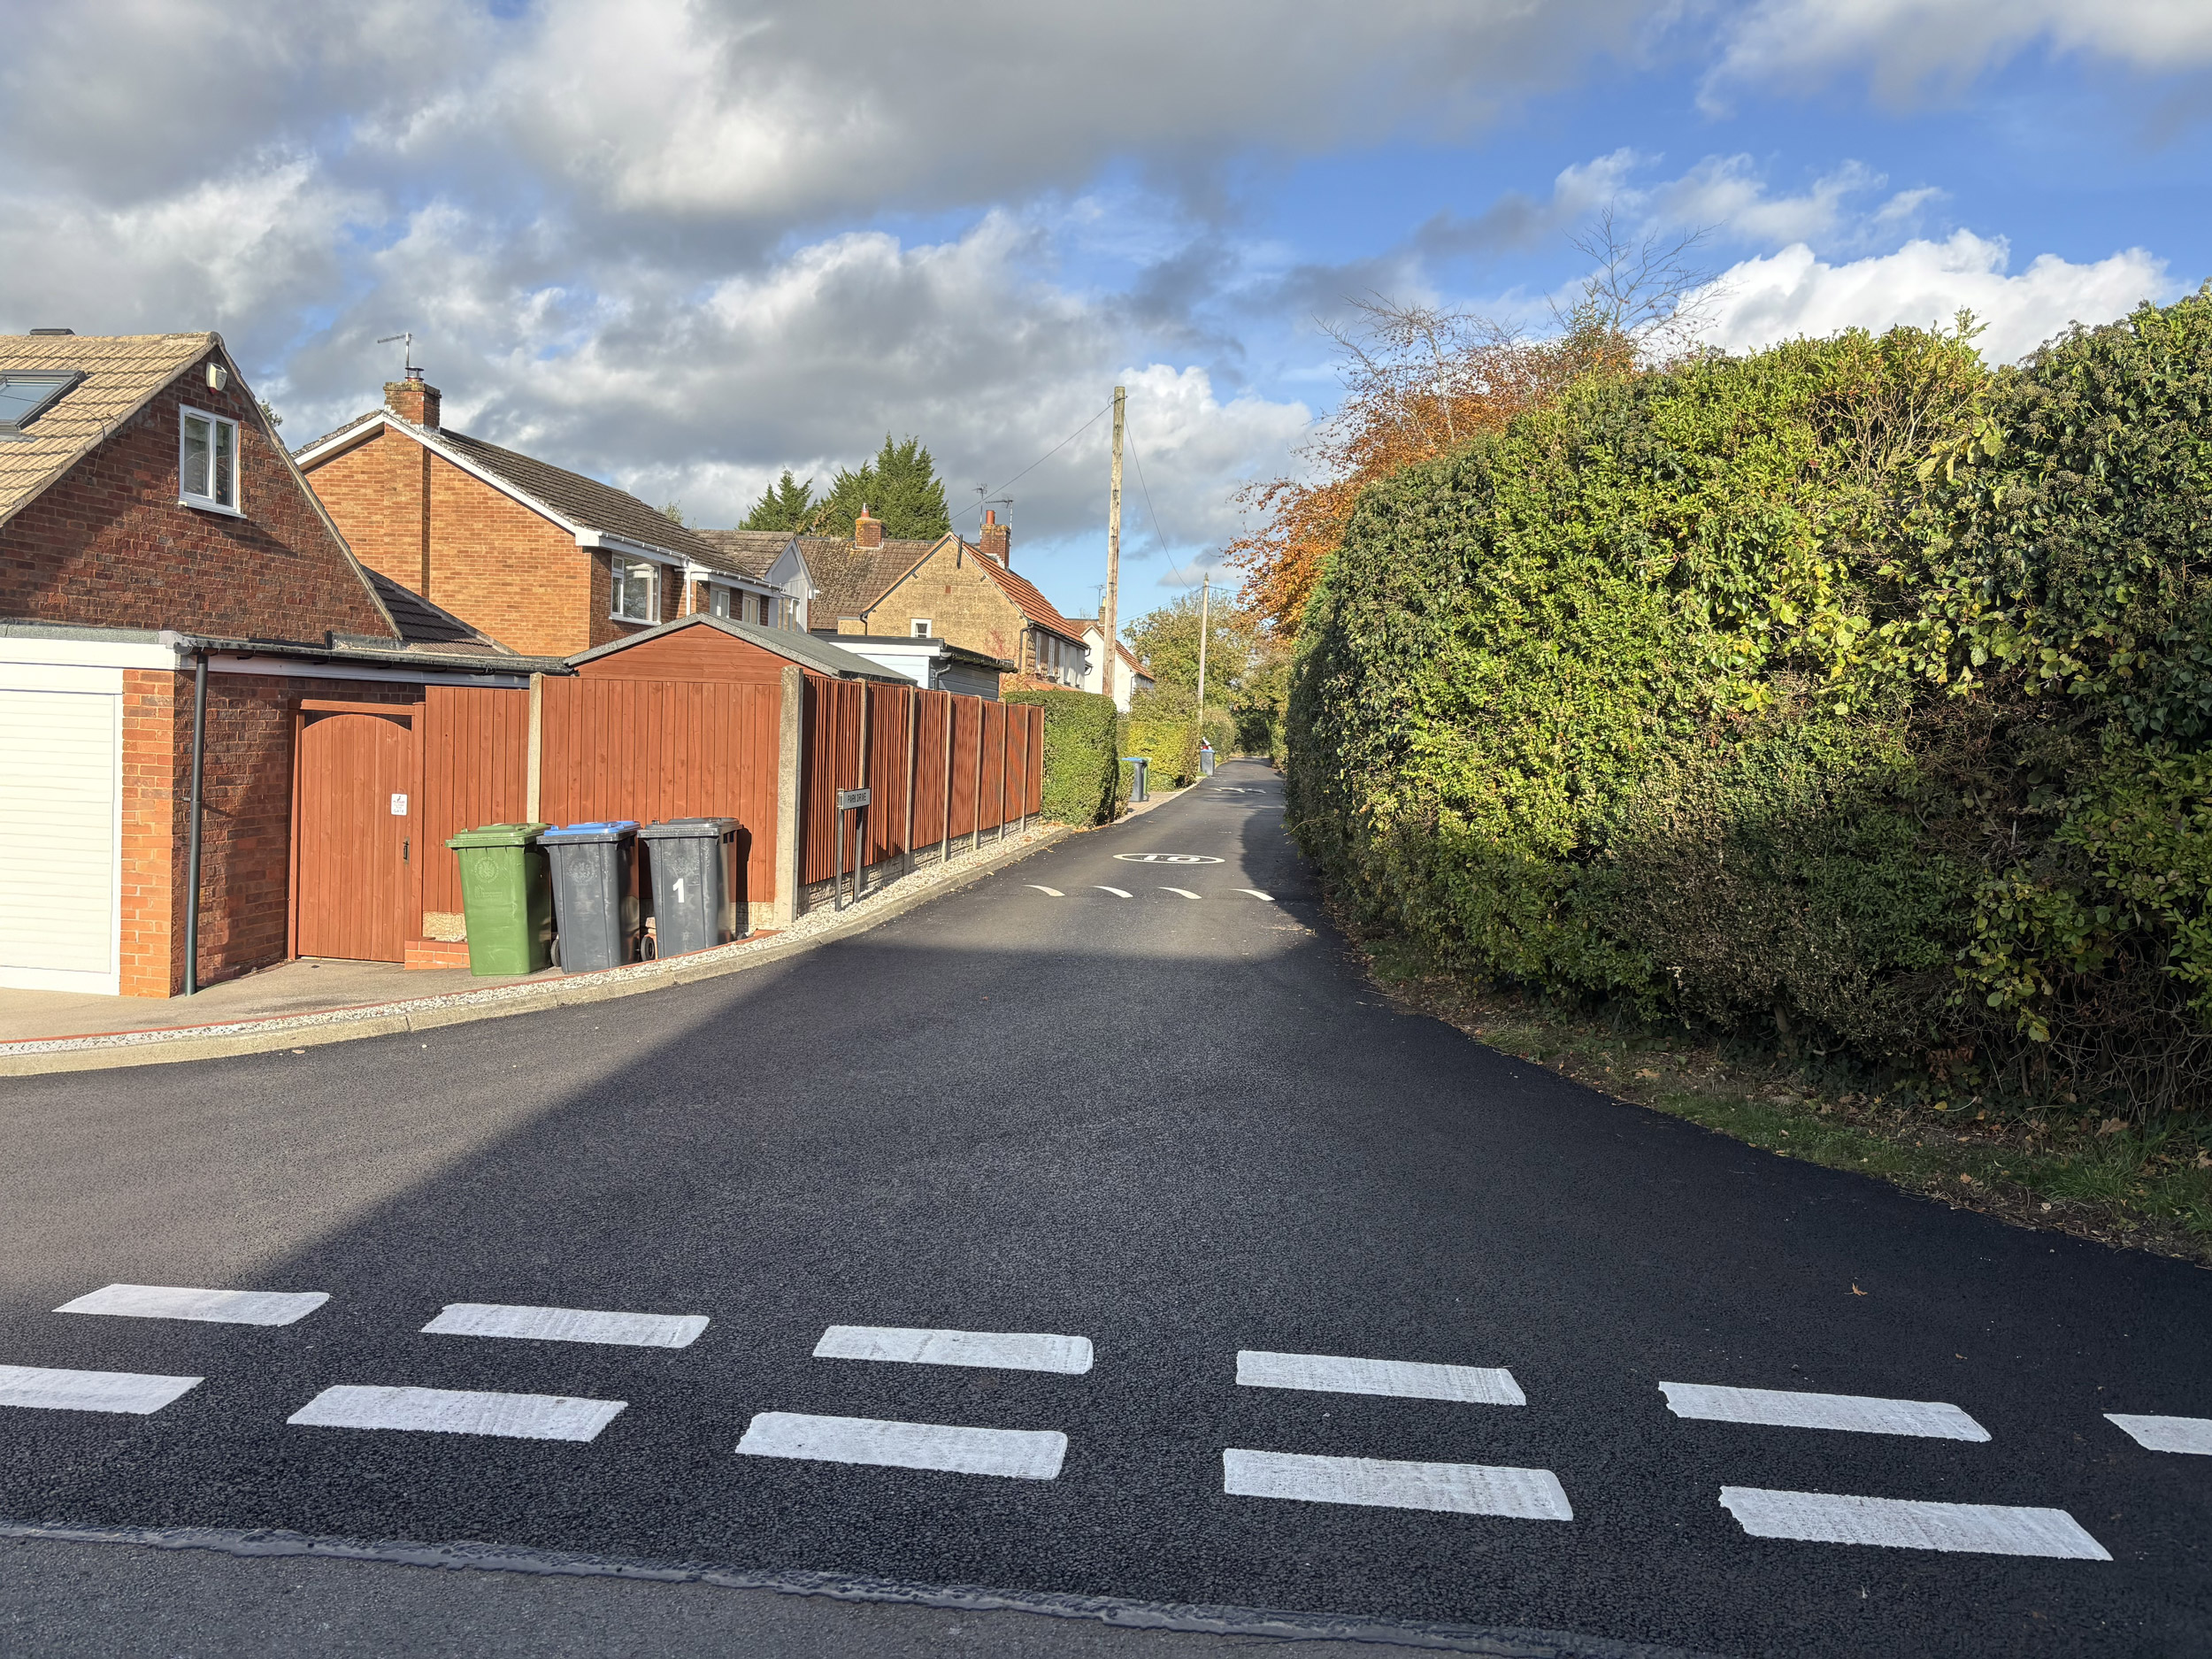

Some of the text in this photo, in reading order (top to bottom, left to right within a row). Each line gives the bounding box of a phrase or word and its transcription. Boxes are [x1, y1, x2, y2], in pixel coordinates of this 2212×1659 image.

[848, 792, 866, 803] PARK DRIVE
[672, 878, 685, 902] 1
